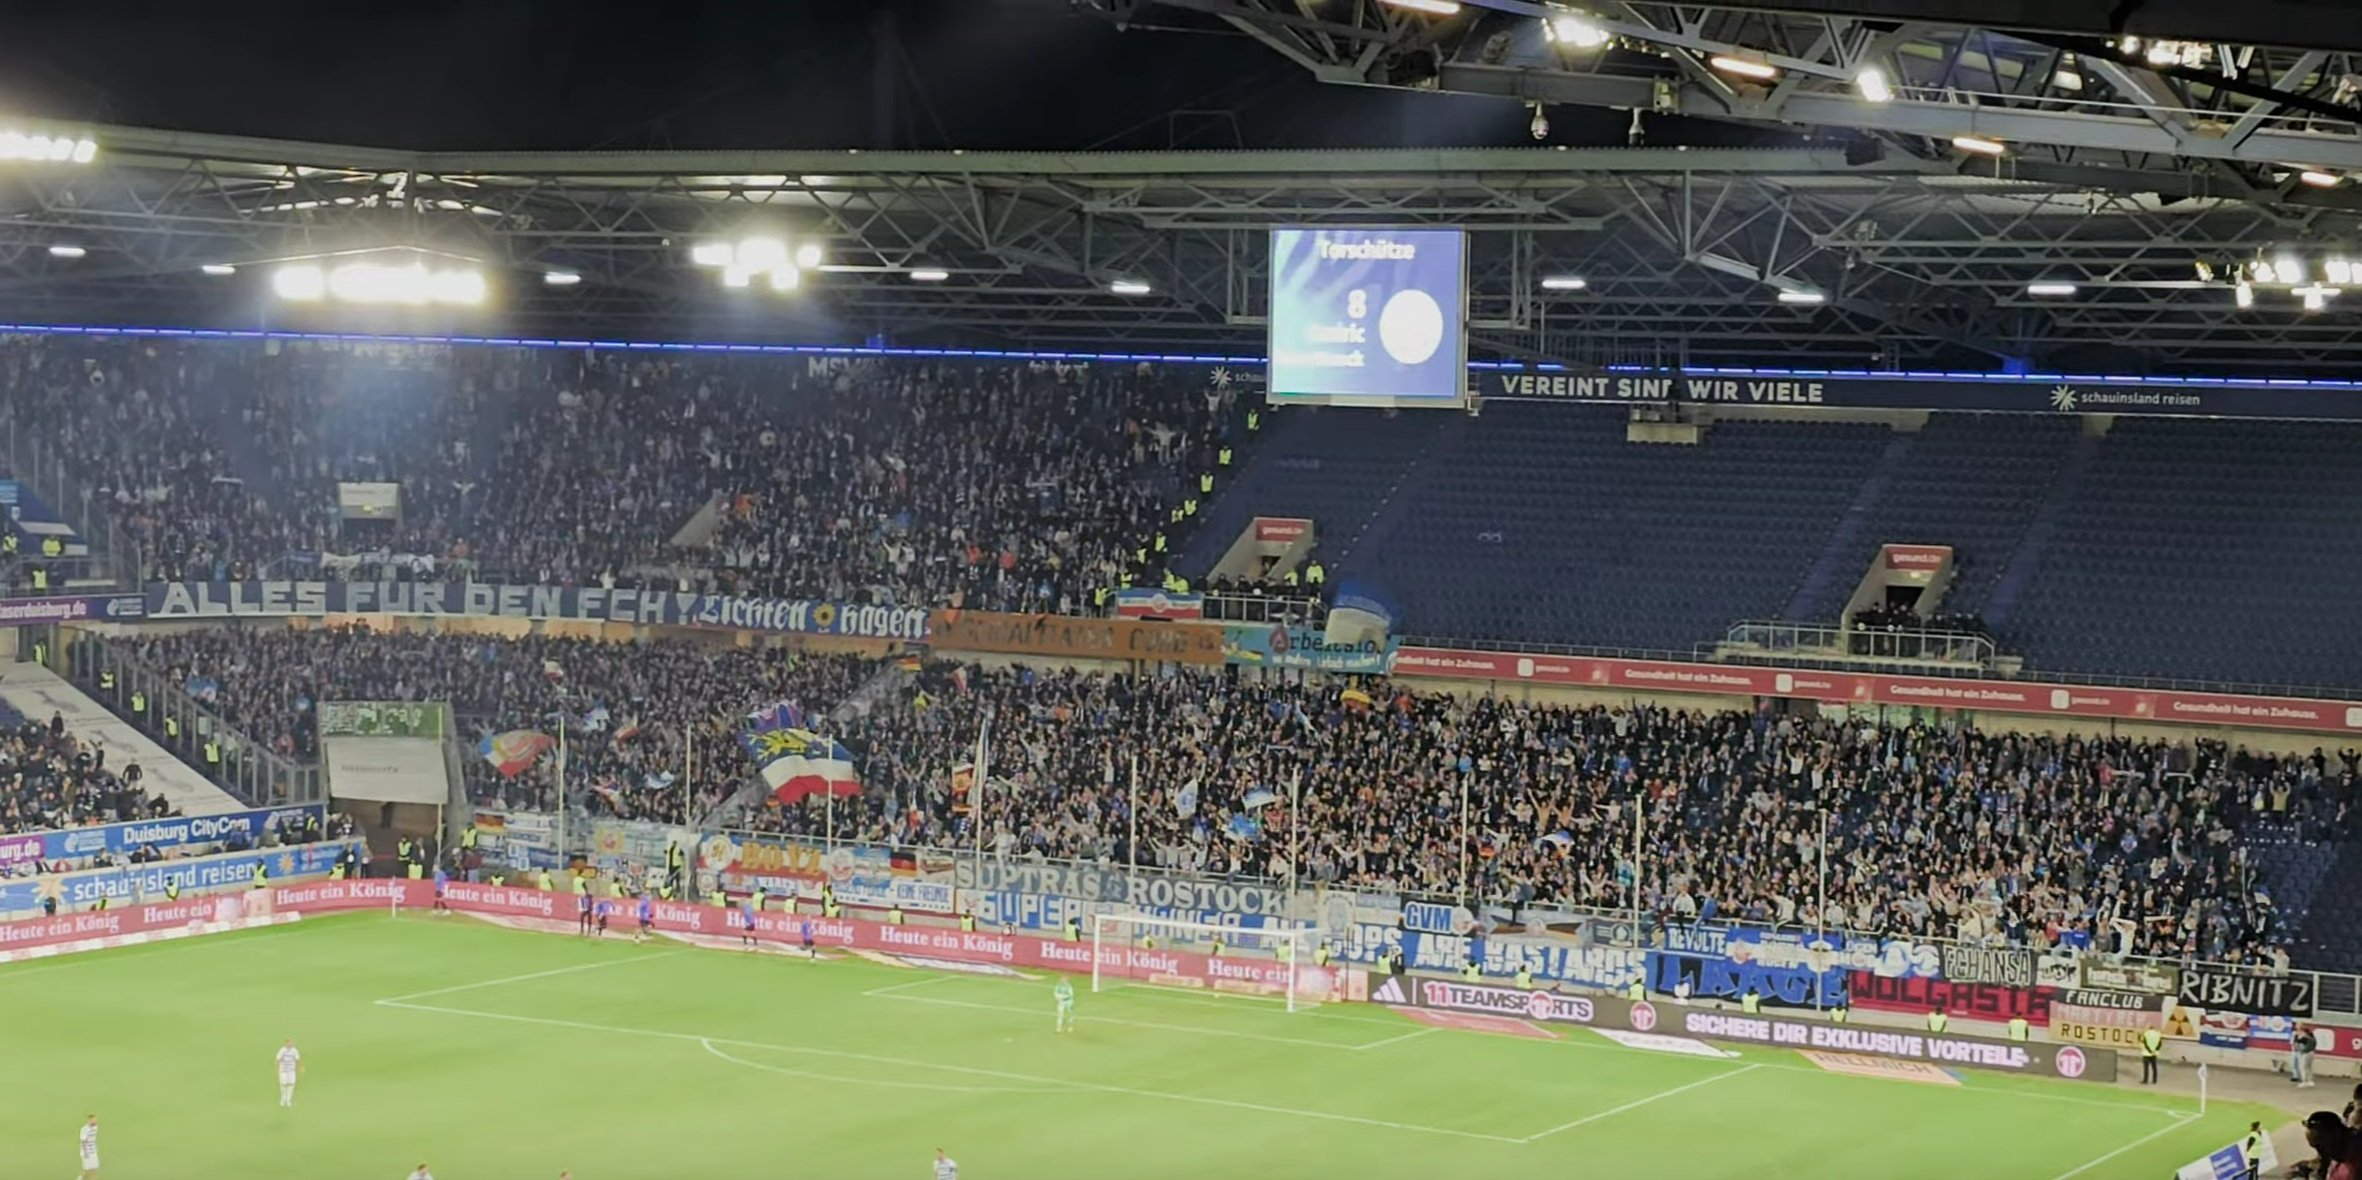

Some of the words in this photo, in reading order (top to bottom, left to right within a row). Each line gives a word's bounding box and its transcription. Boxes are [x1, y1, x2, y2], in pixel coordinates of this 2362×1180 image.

[1502, 375, 1609, 398] VEREINT
[1688, 380, 1738, 400] WIR
[1749, 382, 1823, 402] VIELE
[2081, 391, 2160, 405] schauinsland
[2162, 393, 2201, 406] reisen
[160, 581, 327, 614] ALLES
[464, 580, 562, 618] DEN
[1625, 668, 1676, 681] Gesundheit
[1890, 684, 1944, 697] Gesundheit
[1945, 688, 1962, 698] hat
[1963, 690, 1980, 699] ein
[2173, 701, 2231, 713] Gesundheit
[2233, 703, 2251, 716] hat
[2252, 707, 2269, 717] ein
[2270, 707, 2319, 720] Zuhause.
[123, 822, 188, 844] Duisburg
[277, 887, 322, 905] Heute
[324, 883, 344, 899] ein
[350, 880, 406, 903] König
[956, 860, 1107, 900] SUPTRAS
[1127, 876, 1285, 916] ROSTOCK
[143, 905, 188, 924] Heute
[190, 902, 212, 919] ein
[482, 888, 506, 905] ein
[508, 889, 553, 914] König
[0, 924, 46, 942] Heute
[49, 920, 72, 938] ein
[75, 913, 120, 935] König
[655, 902, 701, 929] König
[777, 914, 801, 933] ein
[1406, 902, 1451, 932] GVM
[880, 924, 929, 947] Heute
[932, 935, 959, 951] ein
[963, 931, 1014, 960] König
[1040, 941, 1092, 963] Heute
[1096, 948, 1121, 965] ein
[1127, 950, 1179, 976] König
[1207, 957, 1260, 980] Heute
[2066, 990, 2144, 1009] FANCLUB
[2180, 969, 2310, 1012] RIBNITZ
[1686, 1012, 1771, 1042] SICHERE
[1773, 1023, 1808, 1045] DIR
[1811, 1028, 1923, 1058] EXKLUSIVE
[2061, 1023, 2145, 1044] ROSTOCK
